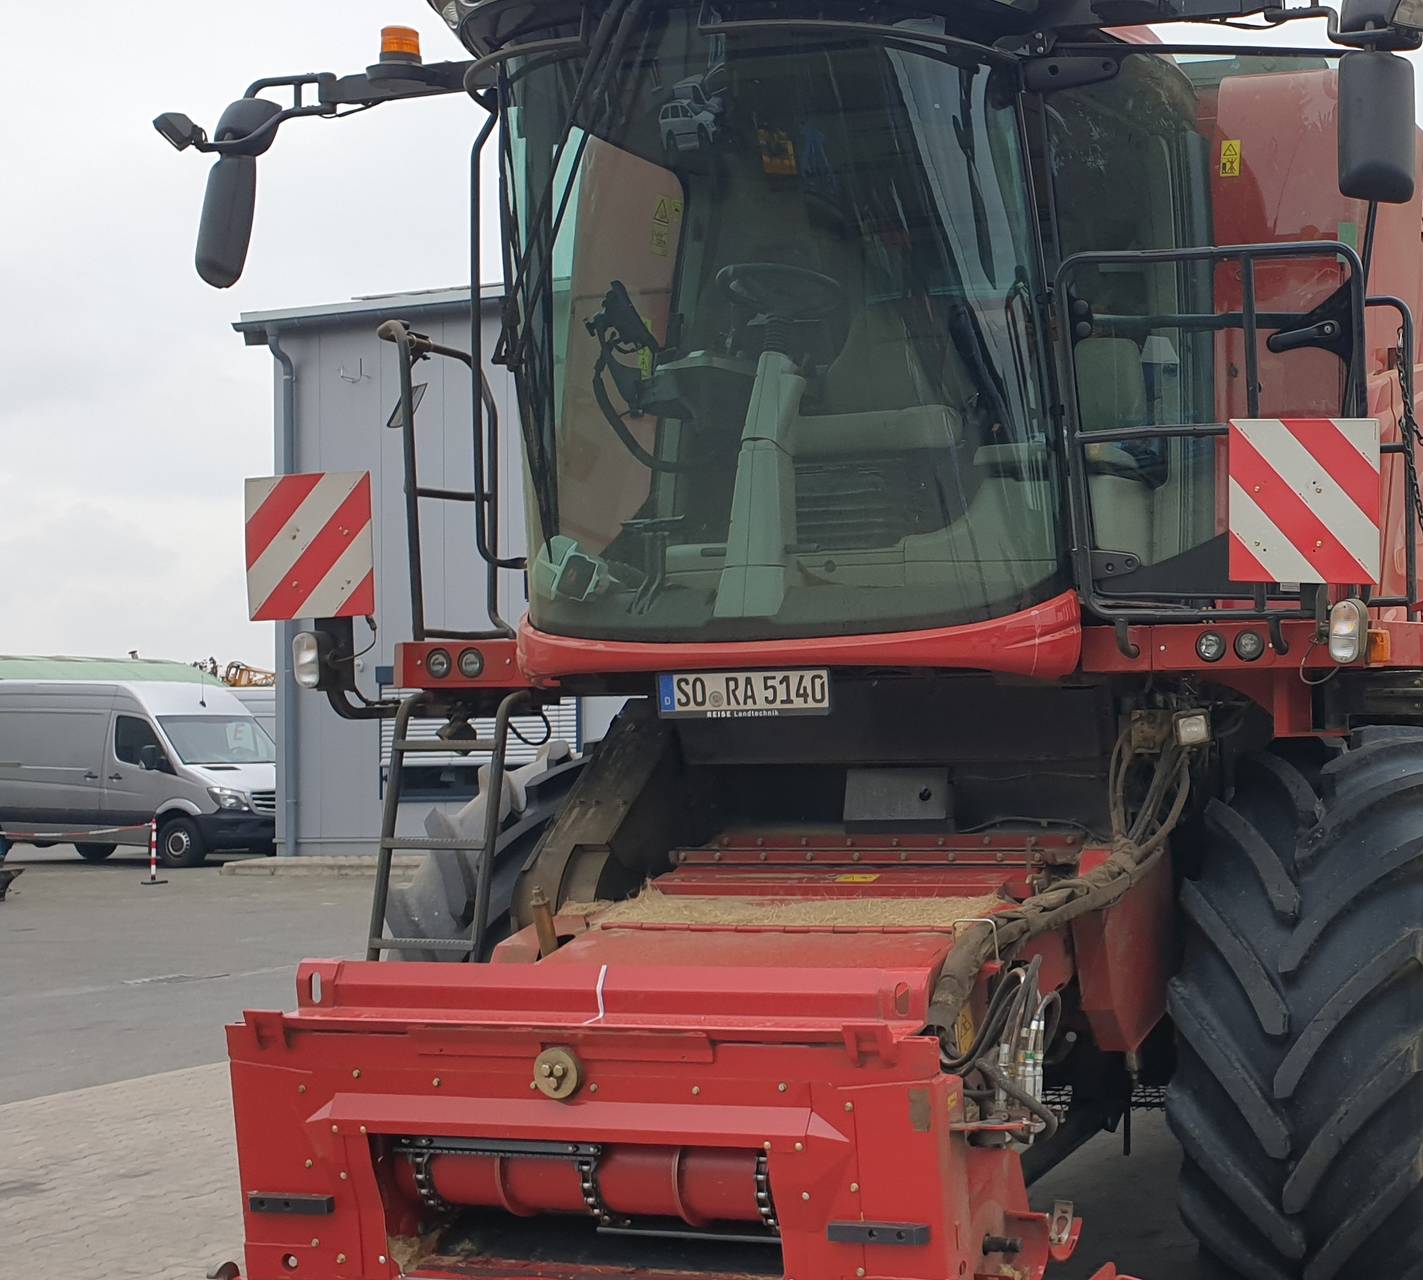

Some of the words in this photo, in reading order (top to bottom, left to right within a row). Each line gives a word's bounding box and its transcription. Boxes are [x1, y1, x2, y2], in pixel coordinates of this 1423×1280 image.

[676, 676, 707, 707] SO
[725, 676, 757, 706] RA
[763, 674, 826, 705] 5140
[733, 709, 780, 718] Landtechnik
